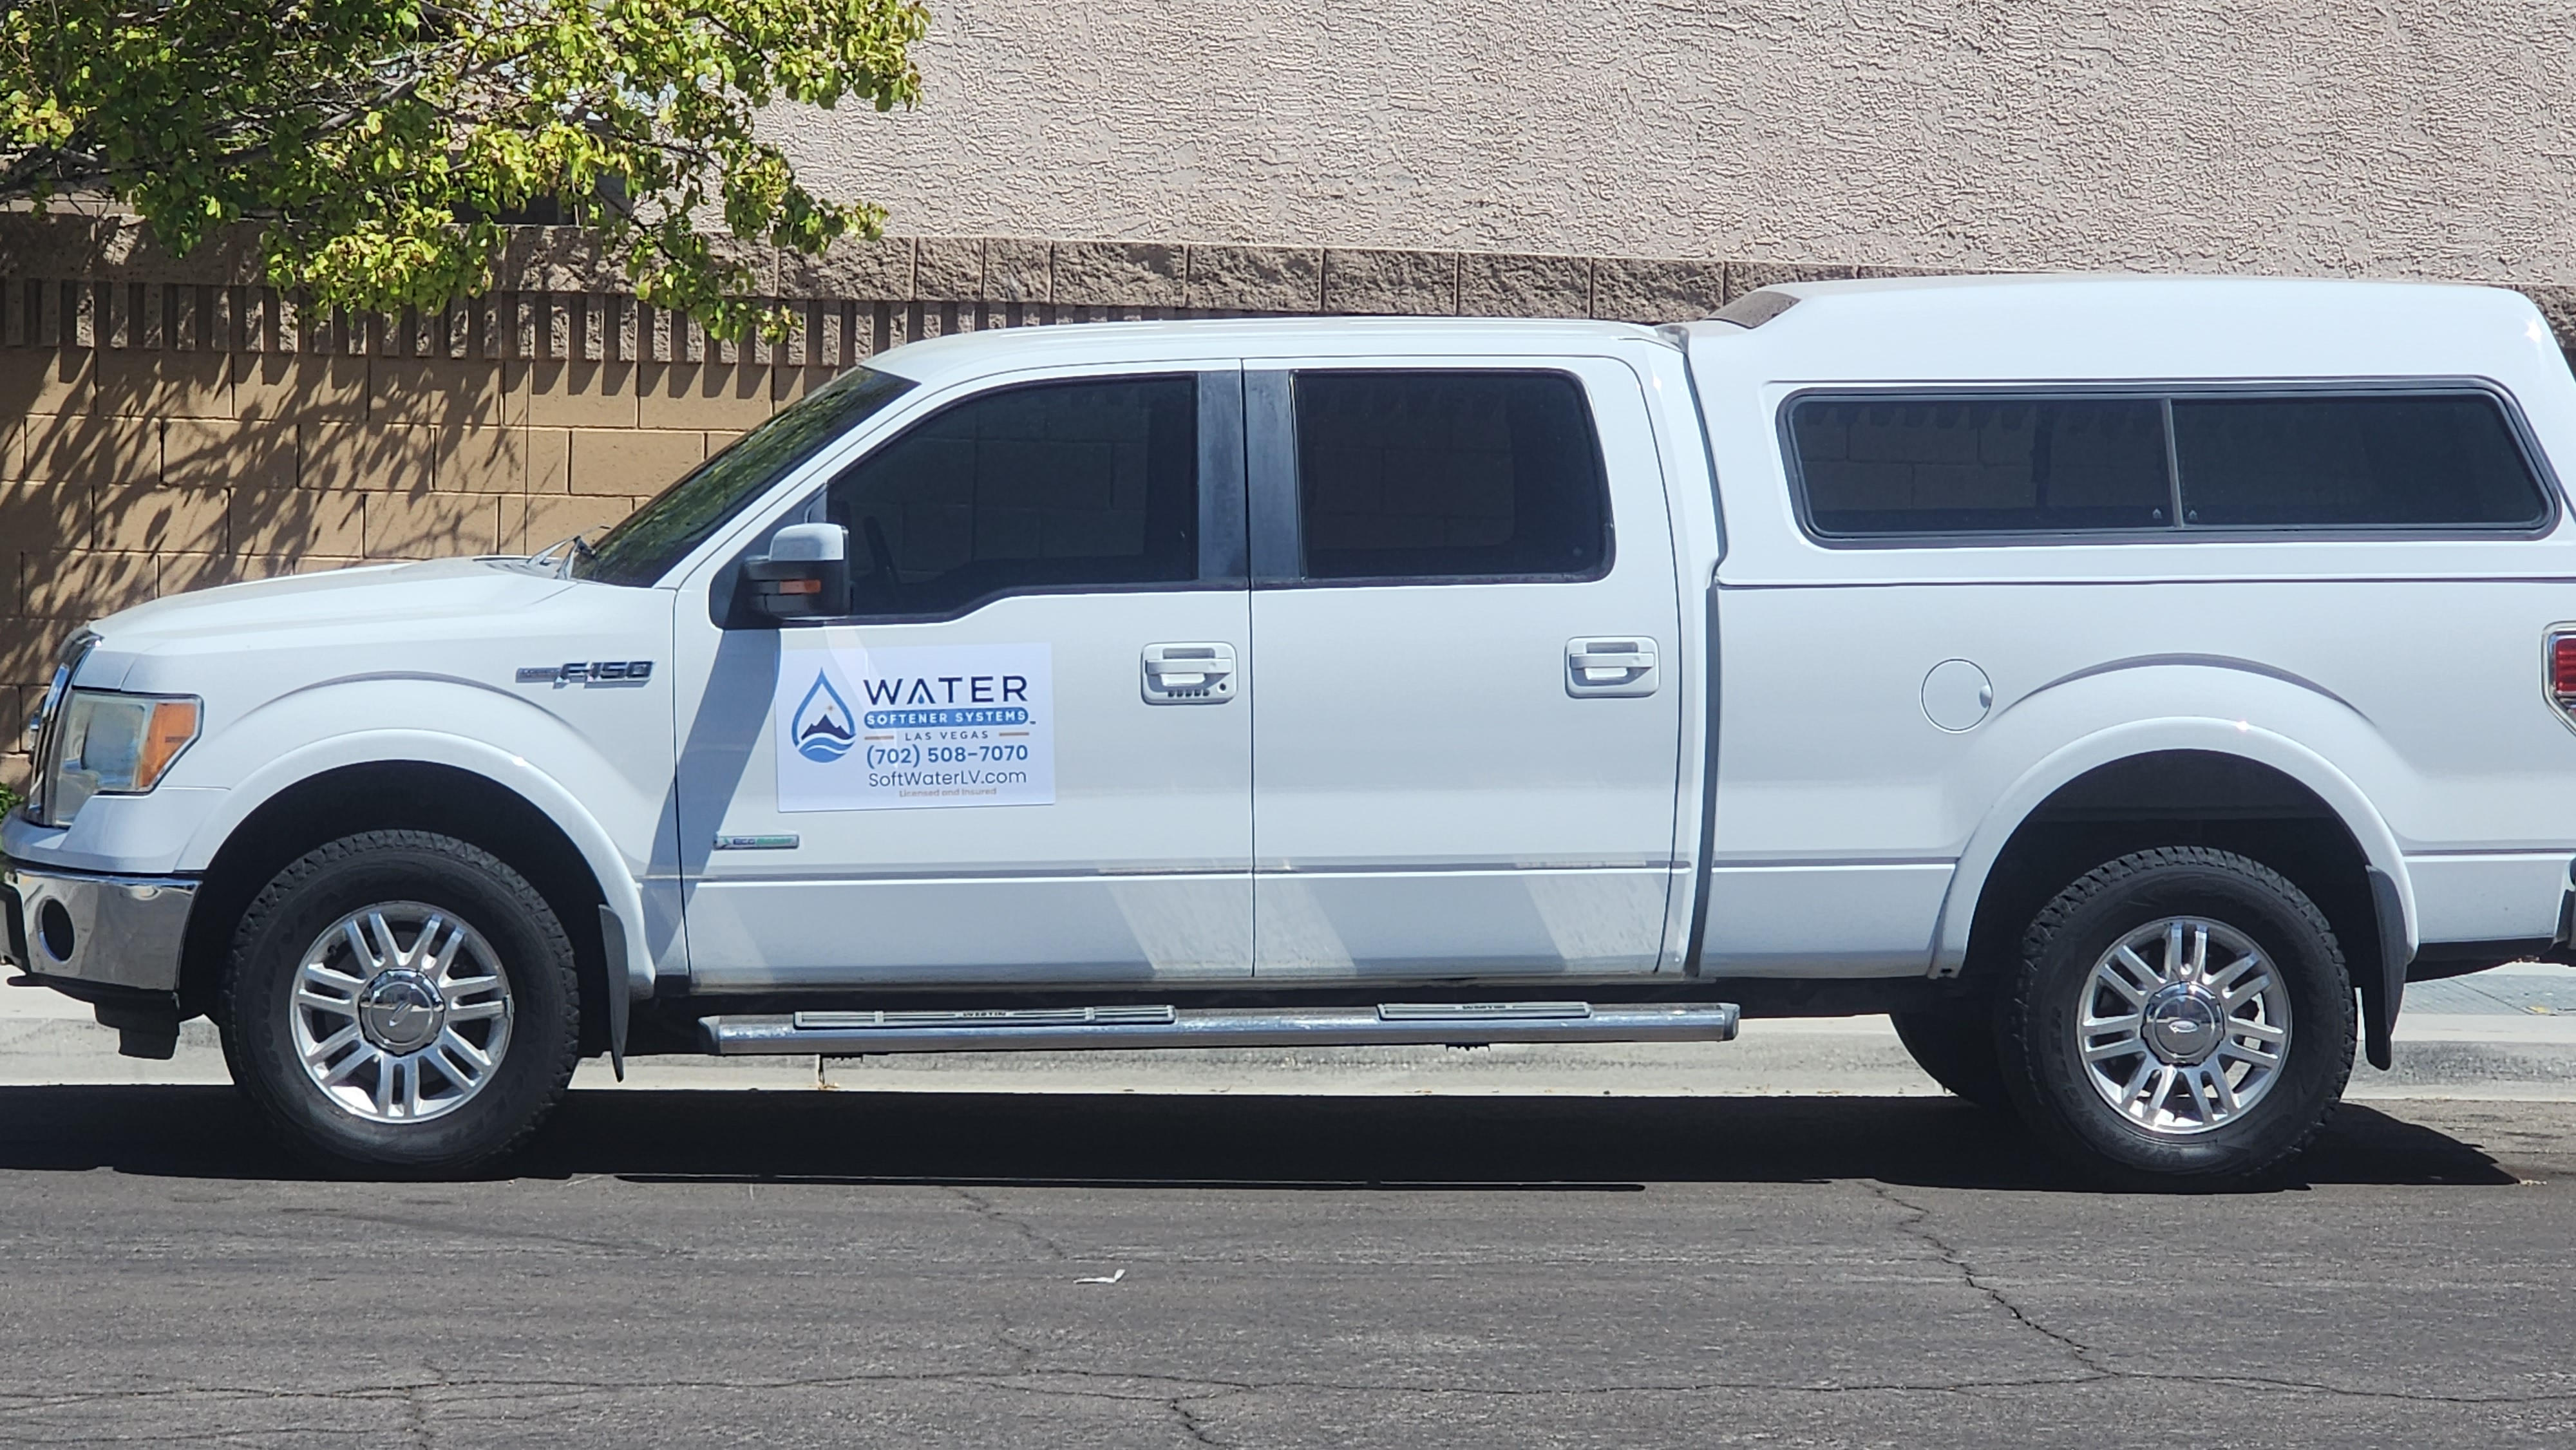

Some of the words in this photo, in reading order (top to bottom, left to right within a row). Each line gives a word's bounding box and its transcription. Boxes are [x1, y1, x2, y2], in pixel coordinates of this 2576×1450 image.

[863, 675, 1028, 706] WATER
[866, 713, 948, 726] SOFTENER
[955, 710, 1026, 722] SYSTEMS
[904, 731, 932, 741] LAS
[940, 730, 989, 740] VEGAS
[866, 743, 921, 769] (702)
[927, 744, 1028, 763] 508-7070
[869, 769, 1027, 787] SoftWaterLV.com
[898, 789, 940, 798] Licensed
[941, 788, 960, 797] and
[961, 787, 998, 796] Insured
